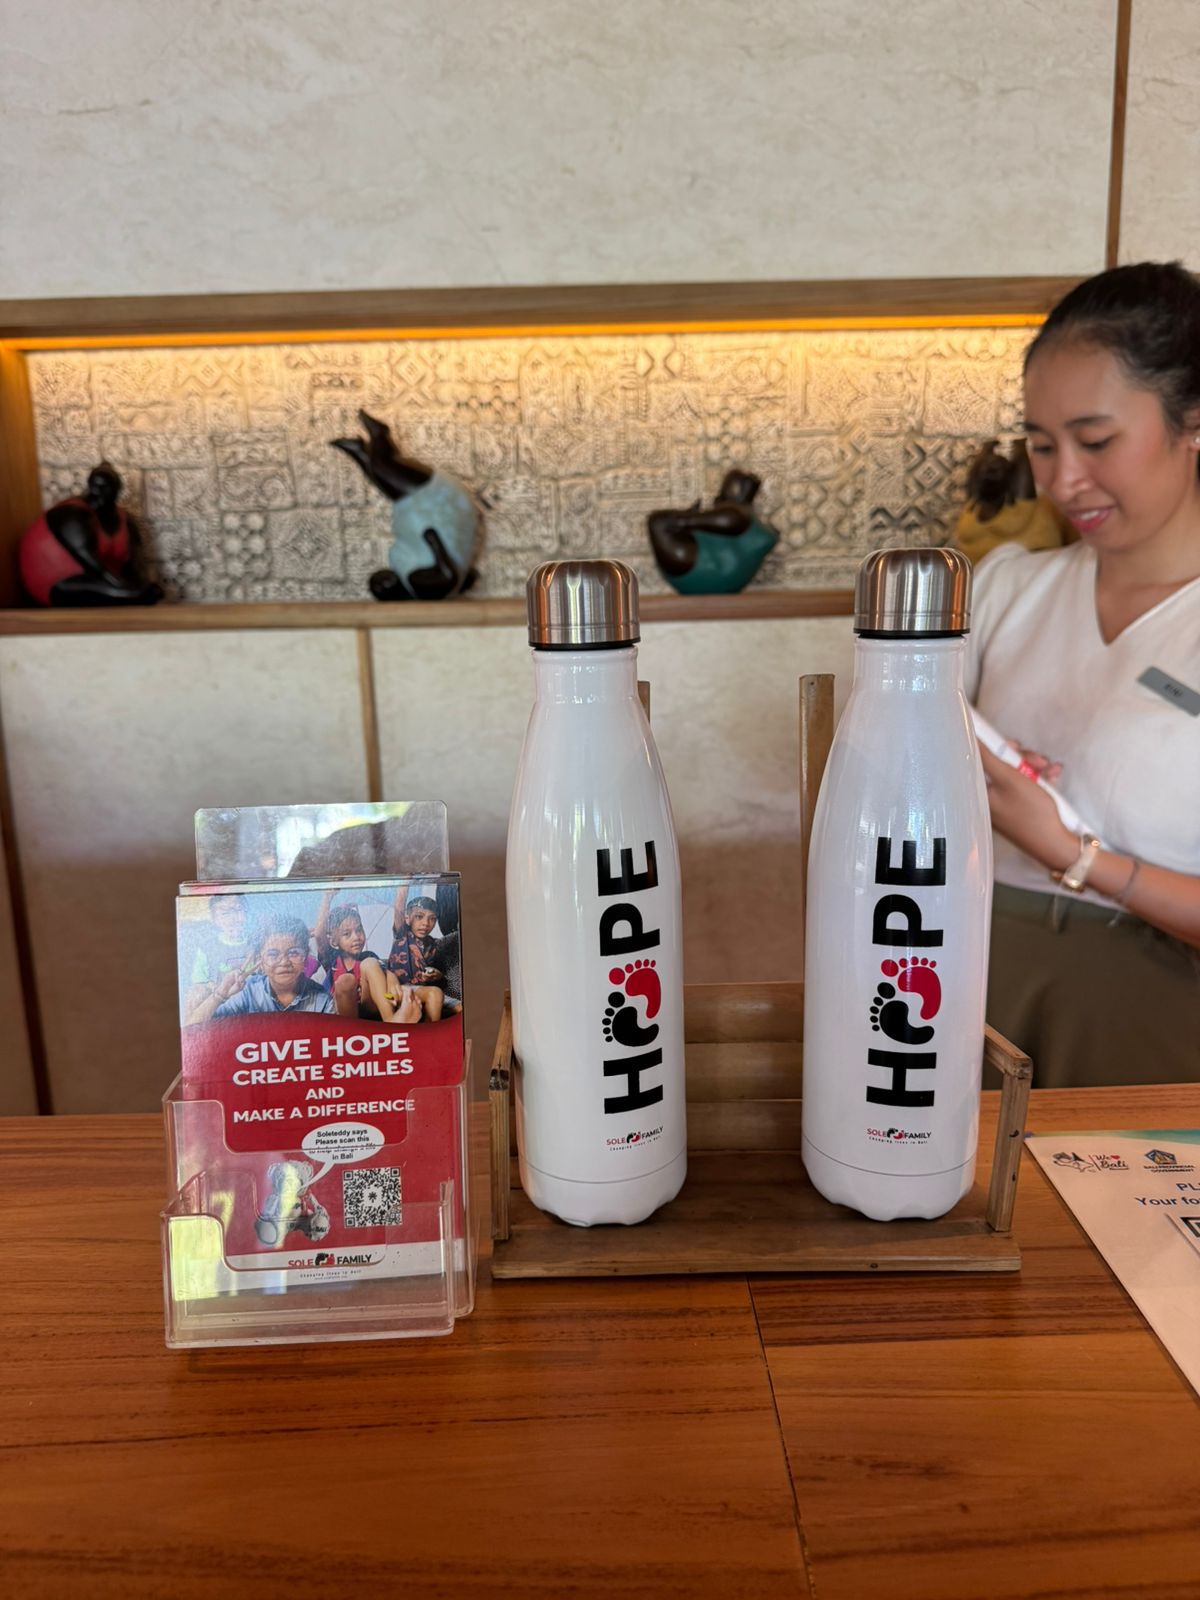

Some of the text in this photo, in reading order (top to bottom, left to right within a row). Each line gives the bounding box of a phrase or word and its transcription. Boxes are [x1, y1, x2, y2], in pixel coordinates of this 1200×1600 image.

[235, 1033, 410, 1064] GIVE HOPE
[232, 1059, 414, 1086] CREATE SMILES
[305, 1087, 345, 1100] AND
[233, 1099, 416, 1123] MAKE A DIFFERENCE
[317, 1130, 350, 1138] Soleteddy
[606, 1126, 664, 1146] SOLE FAMILY
[866, 1128, 886, 1137] SOLE
[1101, 1160, 1127, 1169] Bali
[1176, 1183, 1200, 1191] PL
[1134, 1196, 1200, 1206] Your fo
[288, 1254, 372, 1267] SOLE FAMILY
